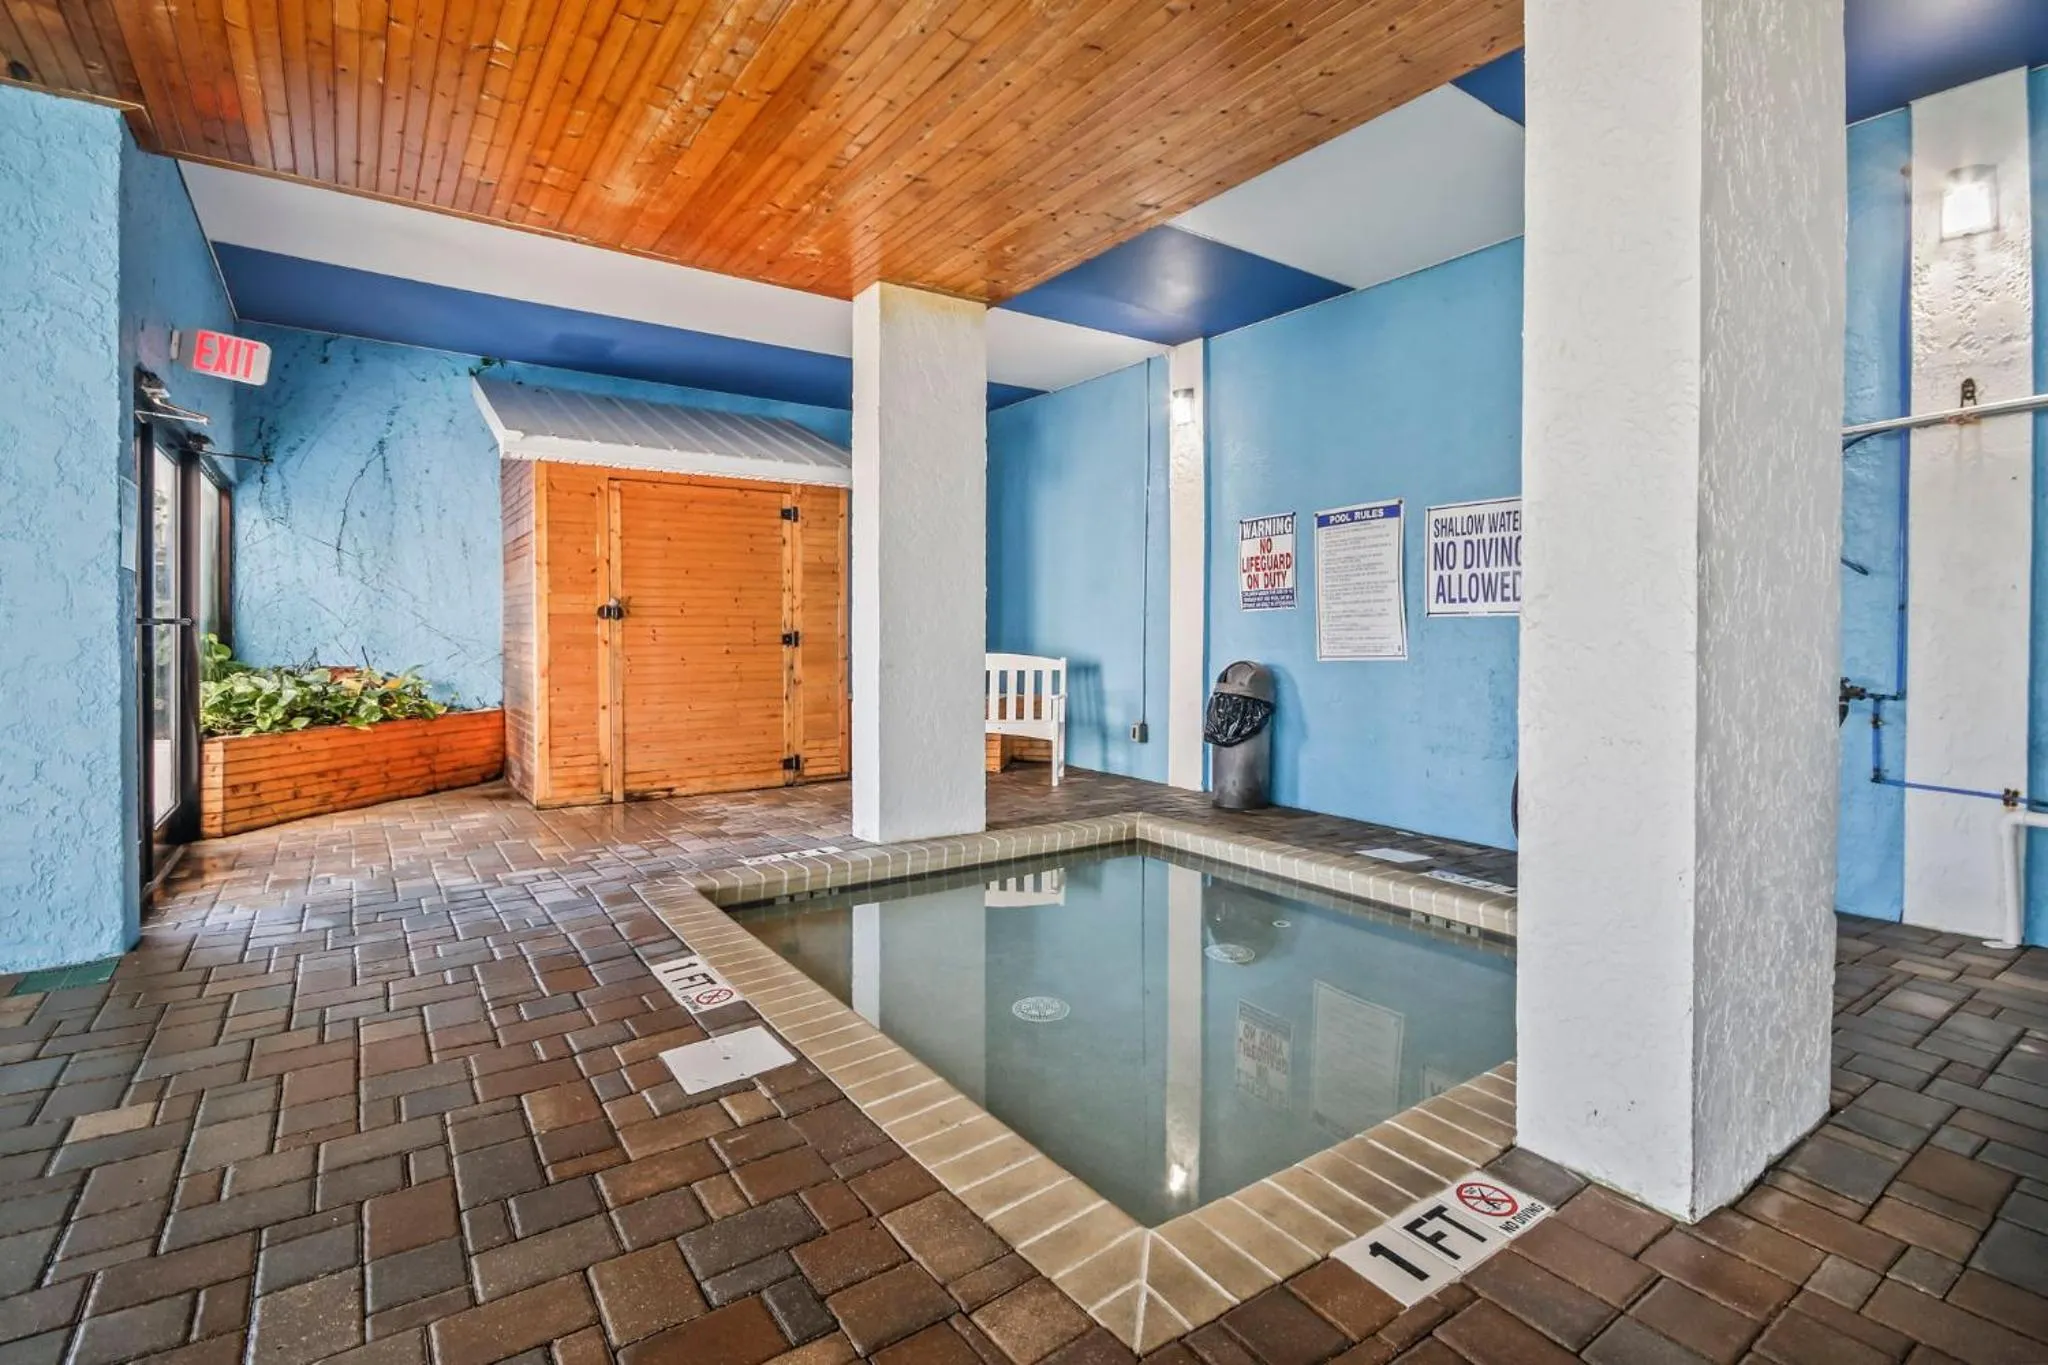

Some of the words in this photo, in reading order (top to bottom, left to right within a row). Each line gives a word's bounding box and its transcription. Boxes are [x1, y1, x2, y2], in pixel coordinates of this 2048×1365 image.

[194, 330, 259, 379] EXIT
[1329, 513, 1351, 525] POOL
[1354, 509, 1384, 521] RULES
[1434, 514, 1485, 538] SHALLOW
[1488, 510, 1522, 533] WATE
[1243, 517, 1292, 539] WARNING
[1260, 538, 1272, 554] NO
[1434, 541, 1457, 571] NO
[1242, 552, 1292, 573] LIFEGUARD
[1247, 574, 1259, 589] ON
[1264, 571, 1287, 588] DUTY
[663, 963, 698, 974] 1
[672, 973, 717, 990] FT
[1499, 1220, 1520, 1233] NO
[1511, 1202, 1545, 1225] DIVING
[1369, 1241, 1431, 1282] 1
[1402, 1204, 1487, 1260] FT
